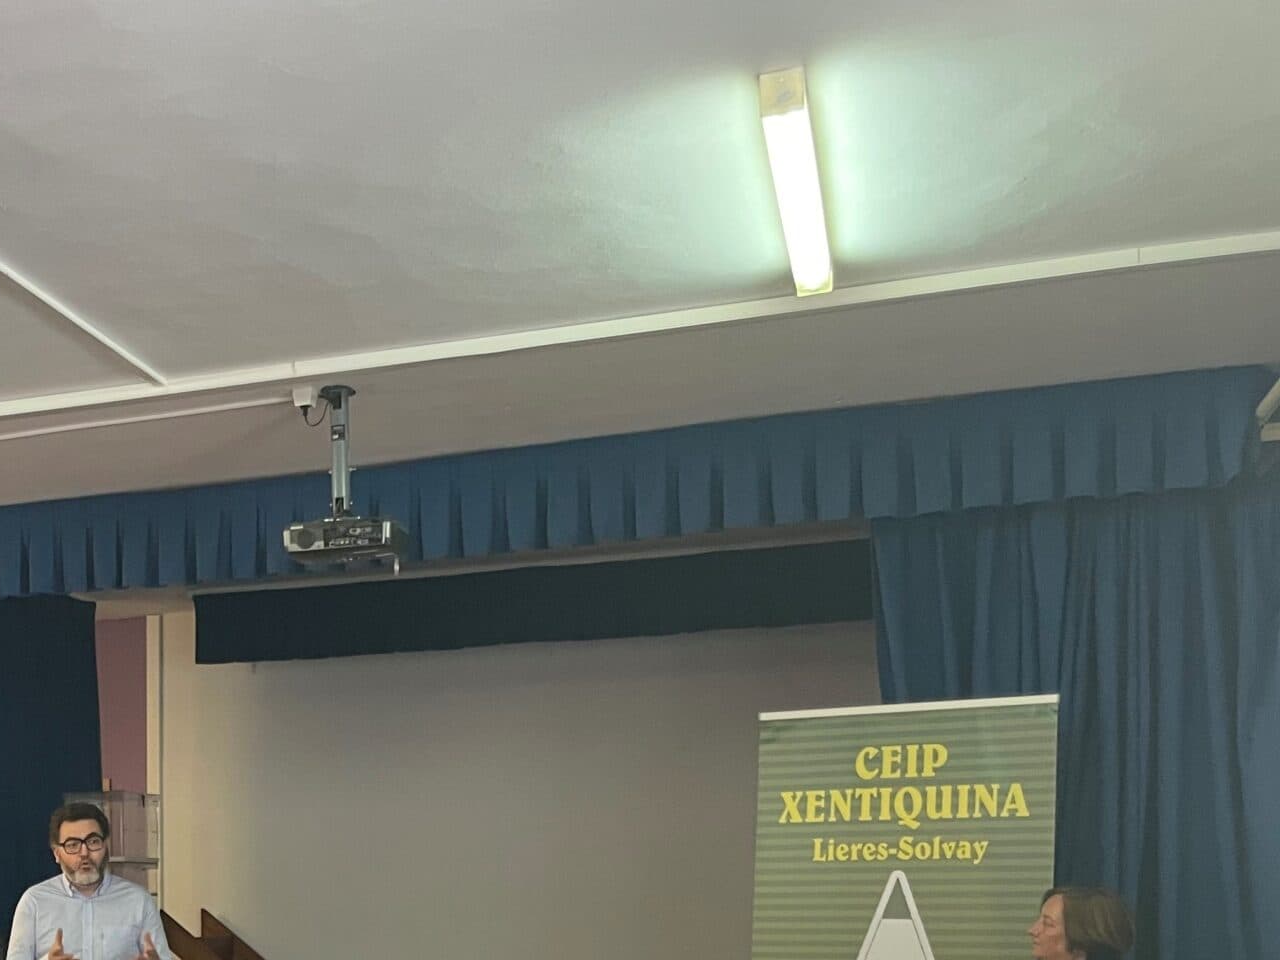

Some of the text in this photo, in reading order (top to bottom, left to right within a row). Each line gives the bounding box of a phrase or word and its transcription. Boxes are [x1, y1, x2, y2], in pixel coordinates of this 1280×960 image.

[855, 743, 948, 780] CEIP
[778, 783, 1030, 830] XENTIQUINA
[812, 836, 988, 864] Lieres-Solvay
